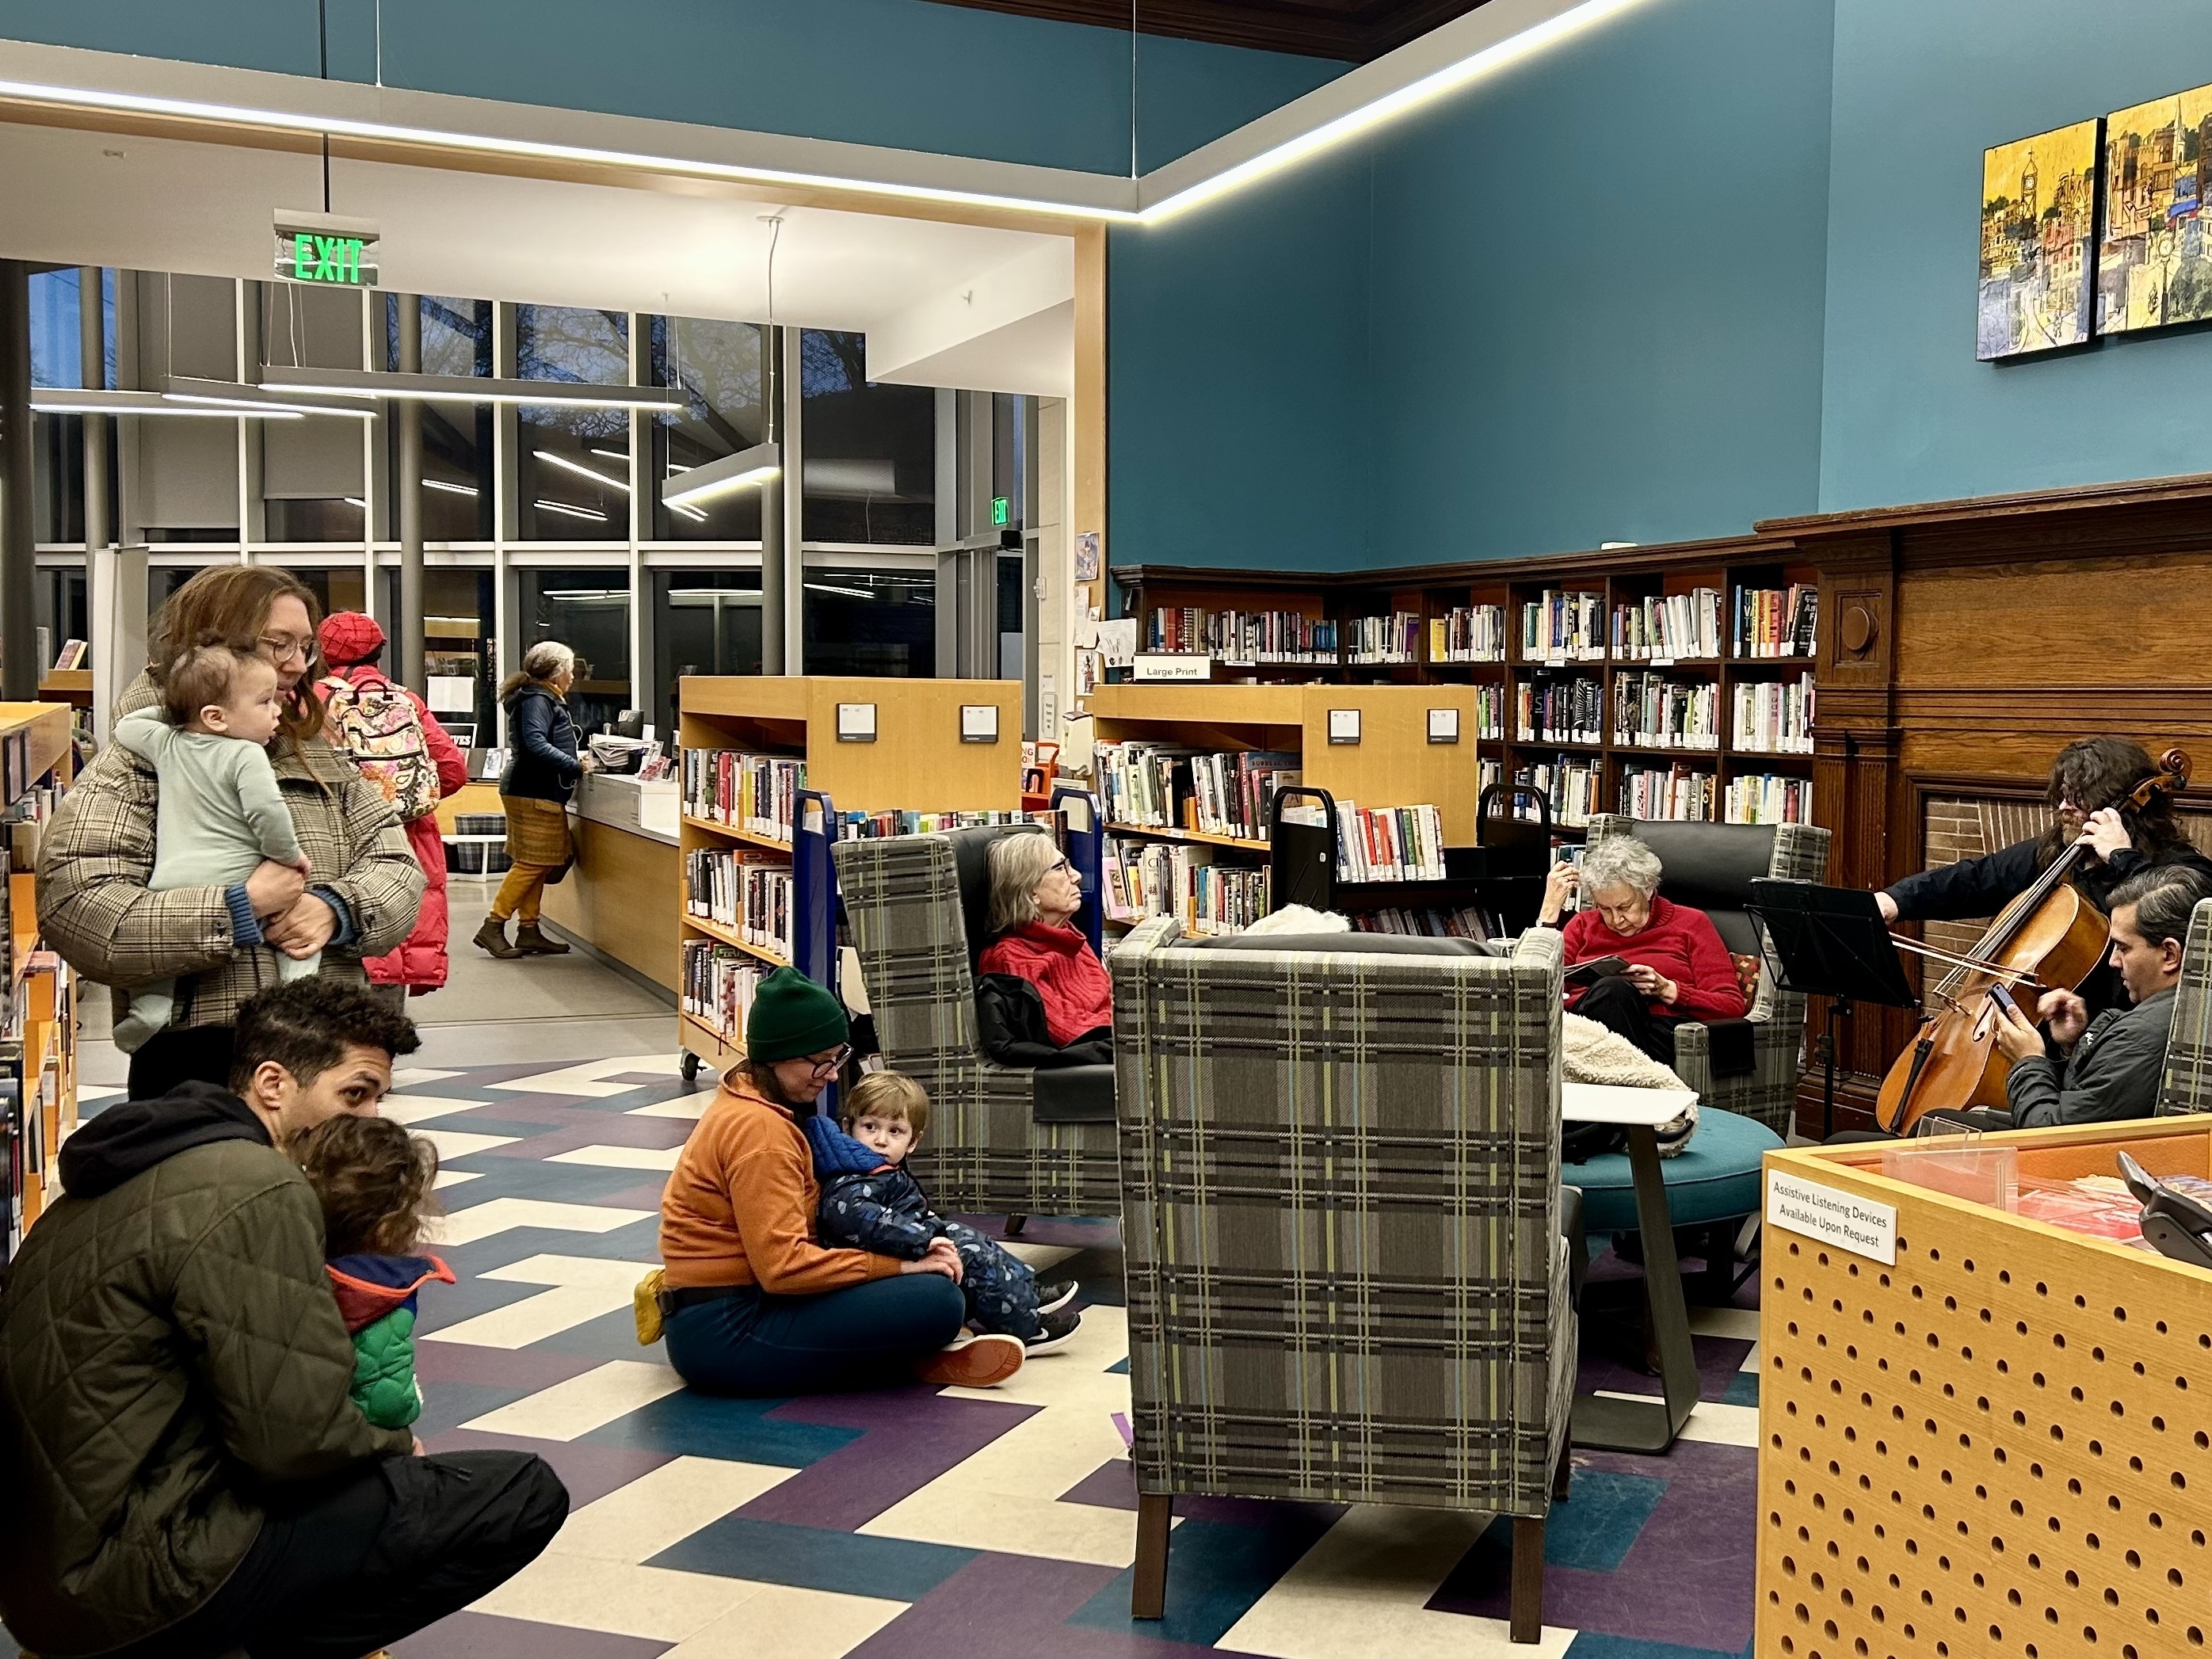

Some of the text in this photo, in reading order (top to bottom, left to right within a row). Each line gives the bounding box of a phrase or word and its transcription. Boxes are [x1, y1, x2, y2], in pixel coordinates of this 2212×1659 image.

[296, 234, 363, 284] EXIT
[1146, 668, 1173, 677] Large
[1774, 1182, 1887, 1228] Assistive Listening Devices
[1779, 1204, 1879, 1247] Available Upon Request
